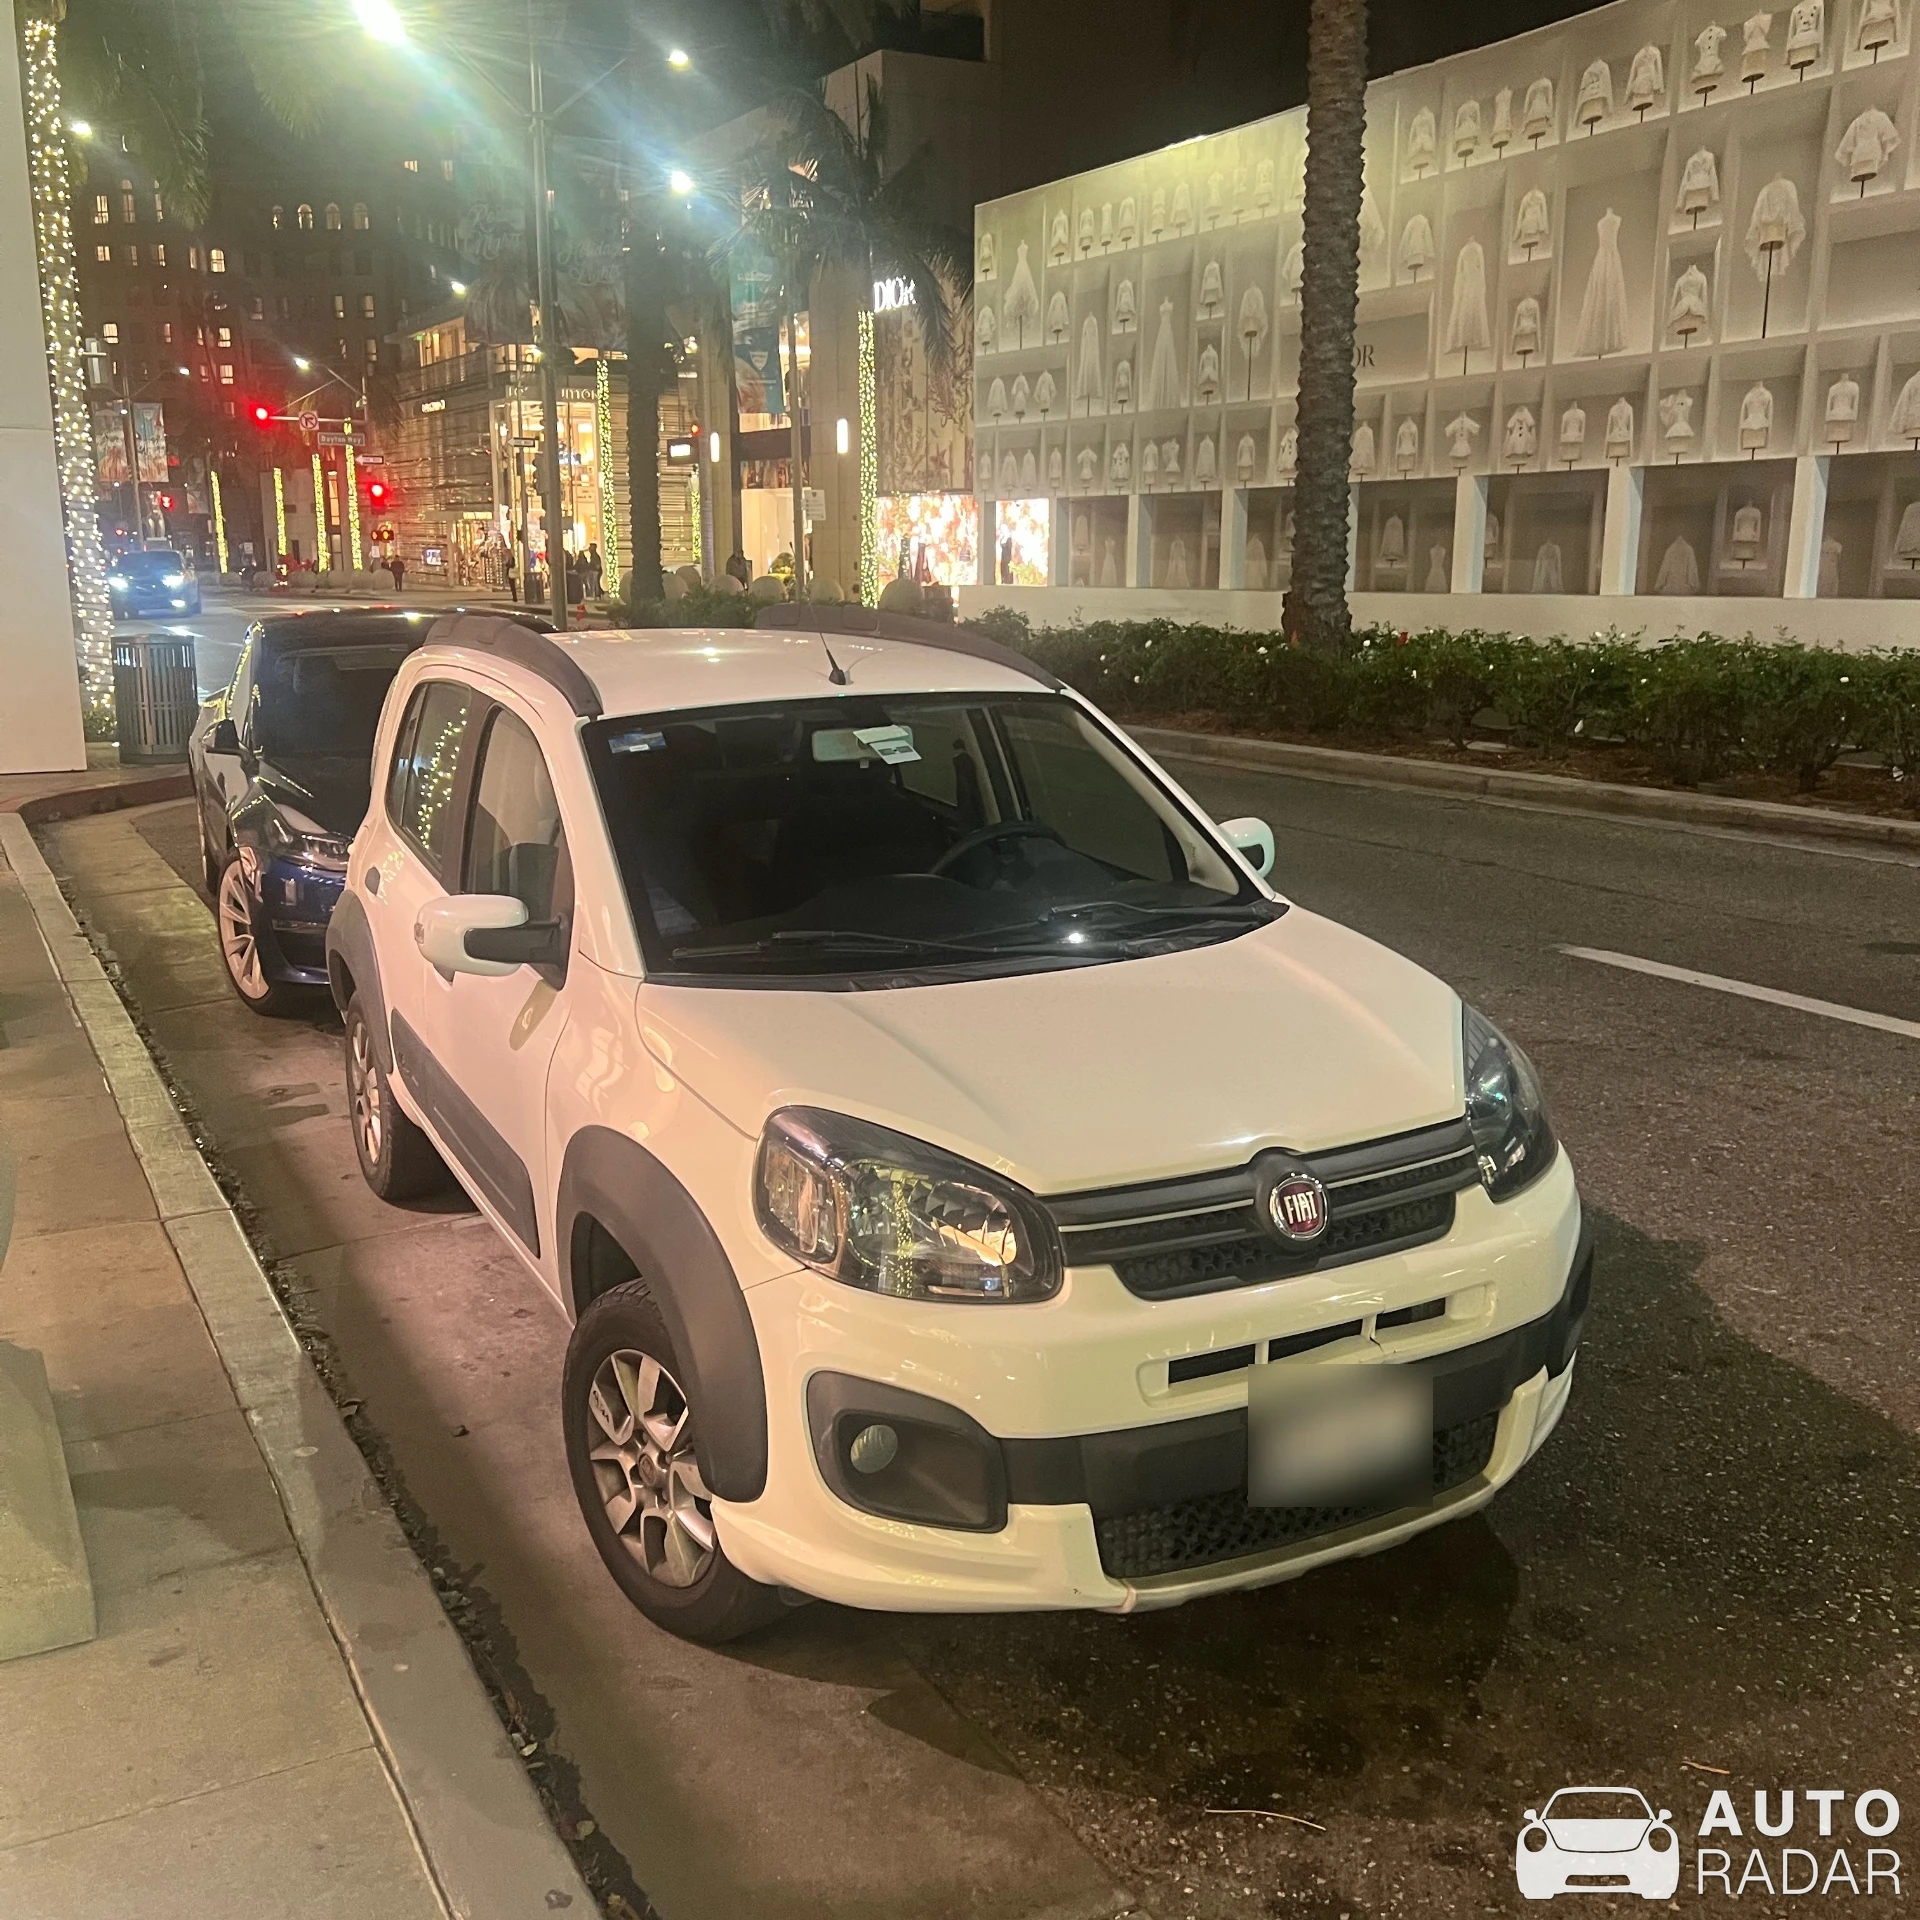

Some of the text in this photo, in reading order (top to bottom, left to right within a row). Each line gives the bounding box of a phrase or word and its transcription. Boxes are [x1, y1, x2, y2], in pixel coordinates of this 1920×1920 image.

[873, 275, 917, 313] DIOR
[321, 435, 346, 444] Dayton
[1283, 1190, 1318, 1224] FIAT
